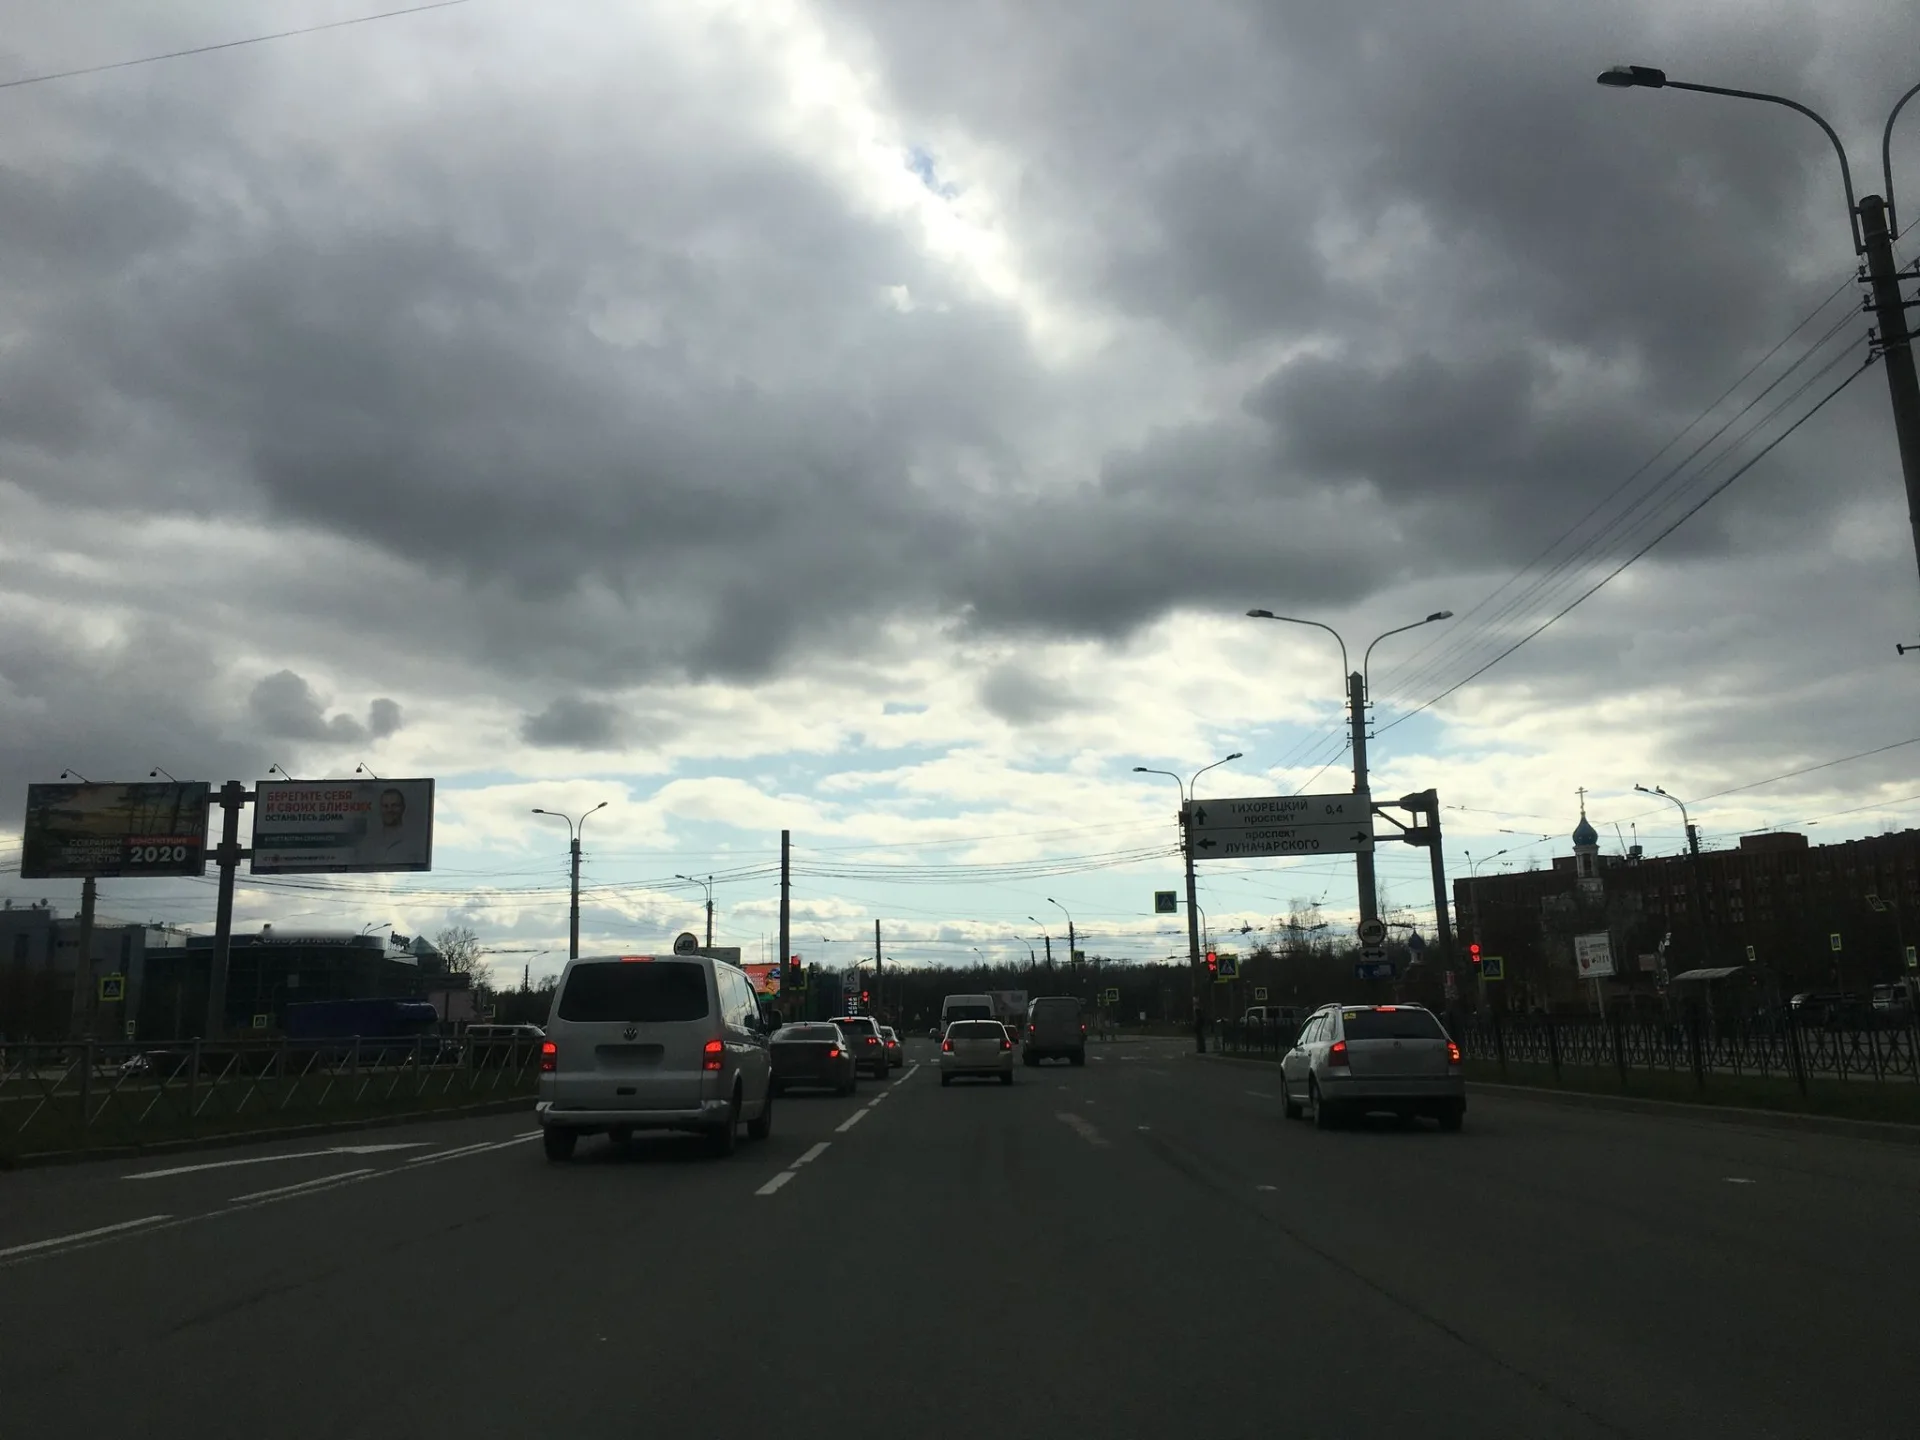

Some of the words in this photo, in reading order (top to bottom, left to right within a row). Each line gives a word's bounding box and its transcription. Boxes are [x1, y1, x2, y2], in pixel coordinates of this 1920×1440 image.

[268, 791, 321, 801] БЕРЕГИТЕ
[324, 790, 352, 800] СЕБЯ
[266, 802, 275, 813] И
[277, 801, 316, 813] СВОИХ
[319, 801, 372, 812] БЛИЗКИХ
[1231, 800, 1308, 814] ТИХОРЕЦКИЙ
[1325, 804, 1343, 816] 0,4
[266, 813, 318, 822] ОСТАНЬТЕСЬ
[319, 812, 344, 821] ДОМА
[1244, 813, 1295, 825] проспект
[1245, 829, 1296, 840] проспект
[1225, 838, 1320, 853] ЛУНАЧАРСКОГО
[130, 846, 187, 863] 2020
